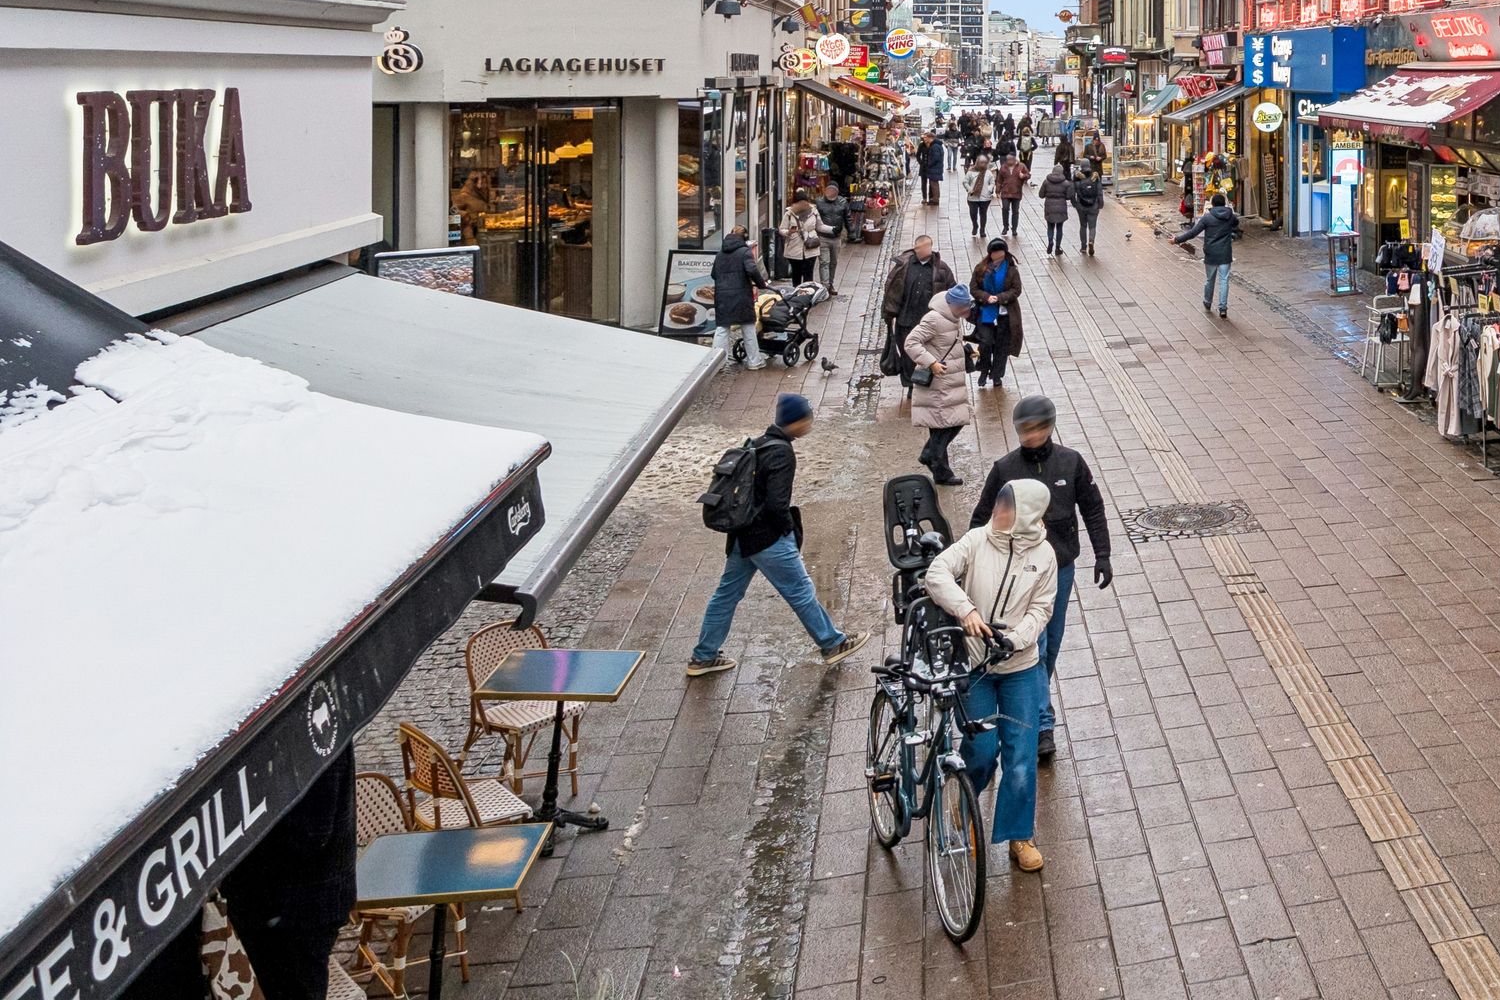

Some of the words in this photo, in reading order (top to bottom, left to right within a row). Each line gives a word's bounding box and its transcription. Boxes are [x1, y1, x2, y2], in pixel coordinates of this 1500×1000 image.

[887, 34, 914, 44] BURGER
[888, 40, 914, 51] KING
[1252, 38, 1264, 51] ¥
[485, 57, 667, 72] LAGKAGEHUSET
[1252, 53, 1264, 66] €
[1252, 69, 1264, 86] $
[462, 112, 497, 120] KAFFETID
[75, 87, 253, 246] BUKA
[91, 897, 132, 982] &
[137, 765, 268, 927] GRILL
